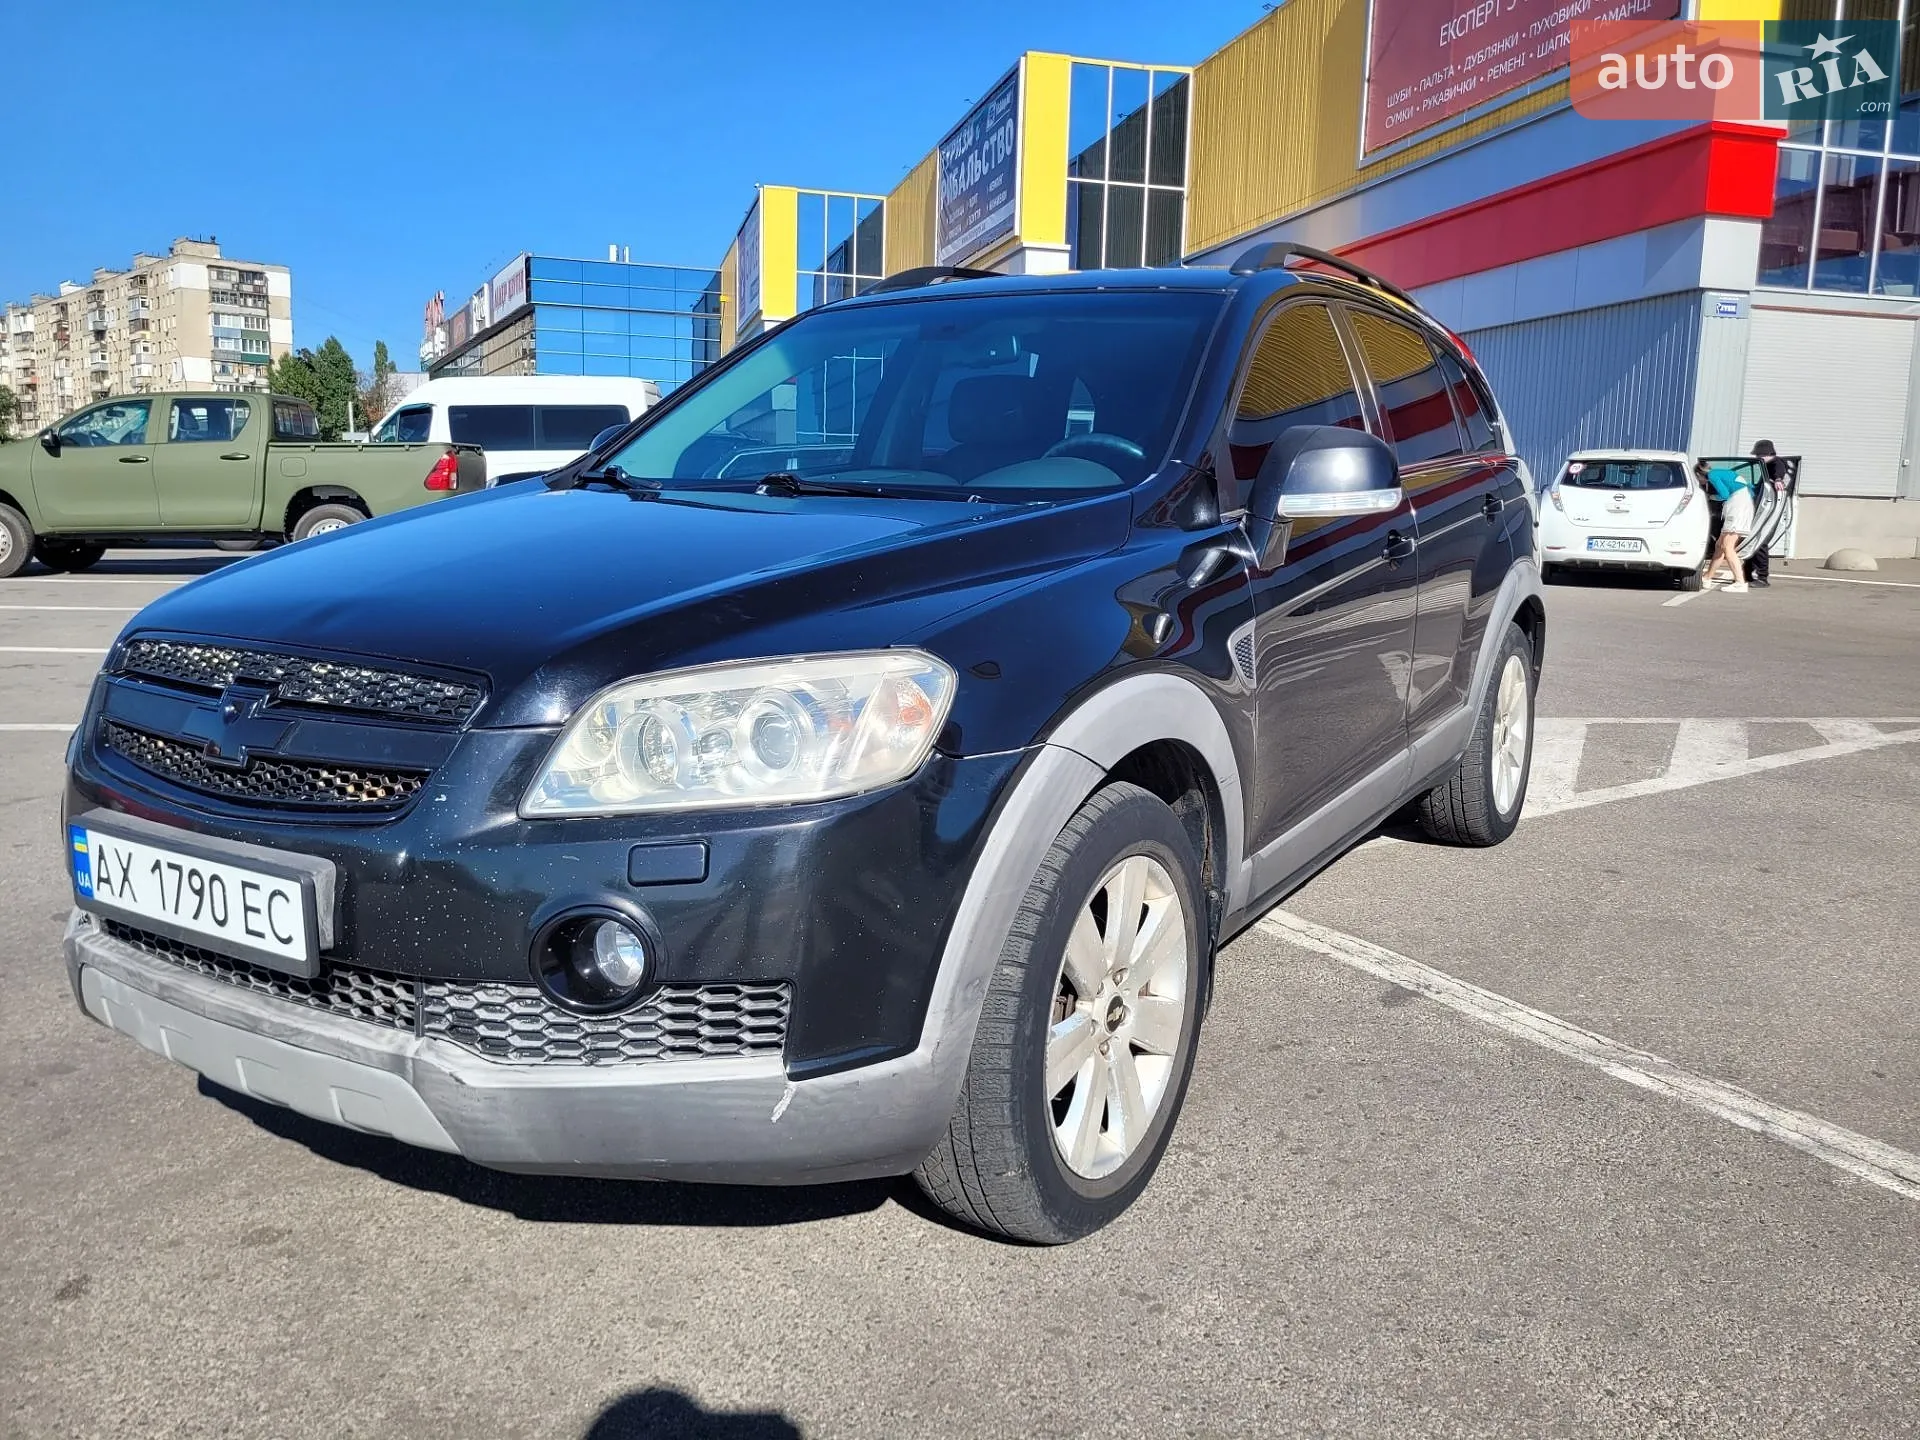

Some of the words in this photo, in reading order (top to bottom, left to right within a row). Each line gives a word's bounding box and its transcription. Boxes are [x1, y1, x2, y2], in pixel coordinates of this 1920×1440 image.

[1387, 86, 1412, 108] ШУБИ
[1419, 64, 1455, 92] ПАЛЬТА
[1464, 32, 1519, 73] ДУБЛЯНКИ
[1529, 0, 1591, 38] ПУХОВИКИ
[1440, 0, 1499, 47] ЕКСПЕРТ
[1385, 106, 1414, 129] СУМКИ
[1422, 76, 1477, 111] РУКАВИЧКИ
[1487, 52, 1526, 82] РЕМЕНІ
[1537, 26, 1580, 58] ШАПКИ
[1593, 540, 1606, 548] AX
[77, 870, 92, 889] UA
[97, 844, 137, 903] AX
[151, 859, 229, 928] 1790
[241, 880, 293, 945] EC
